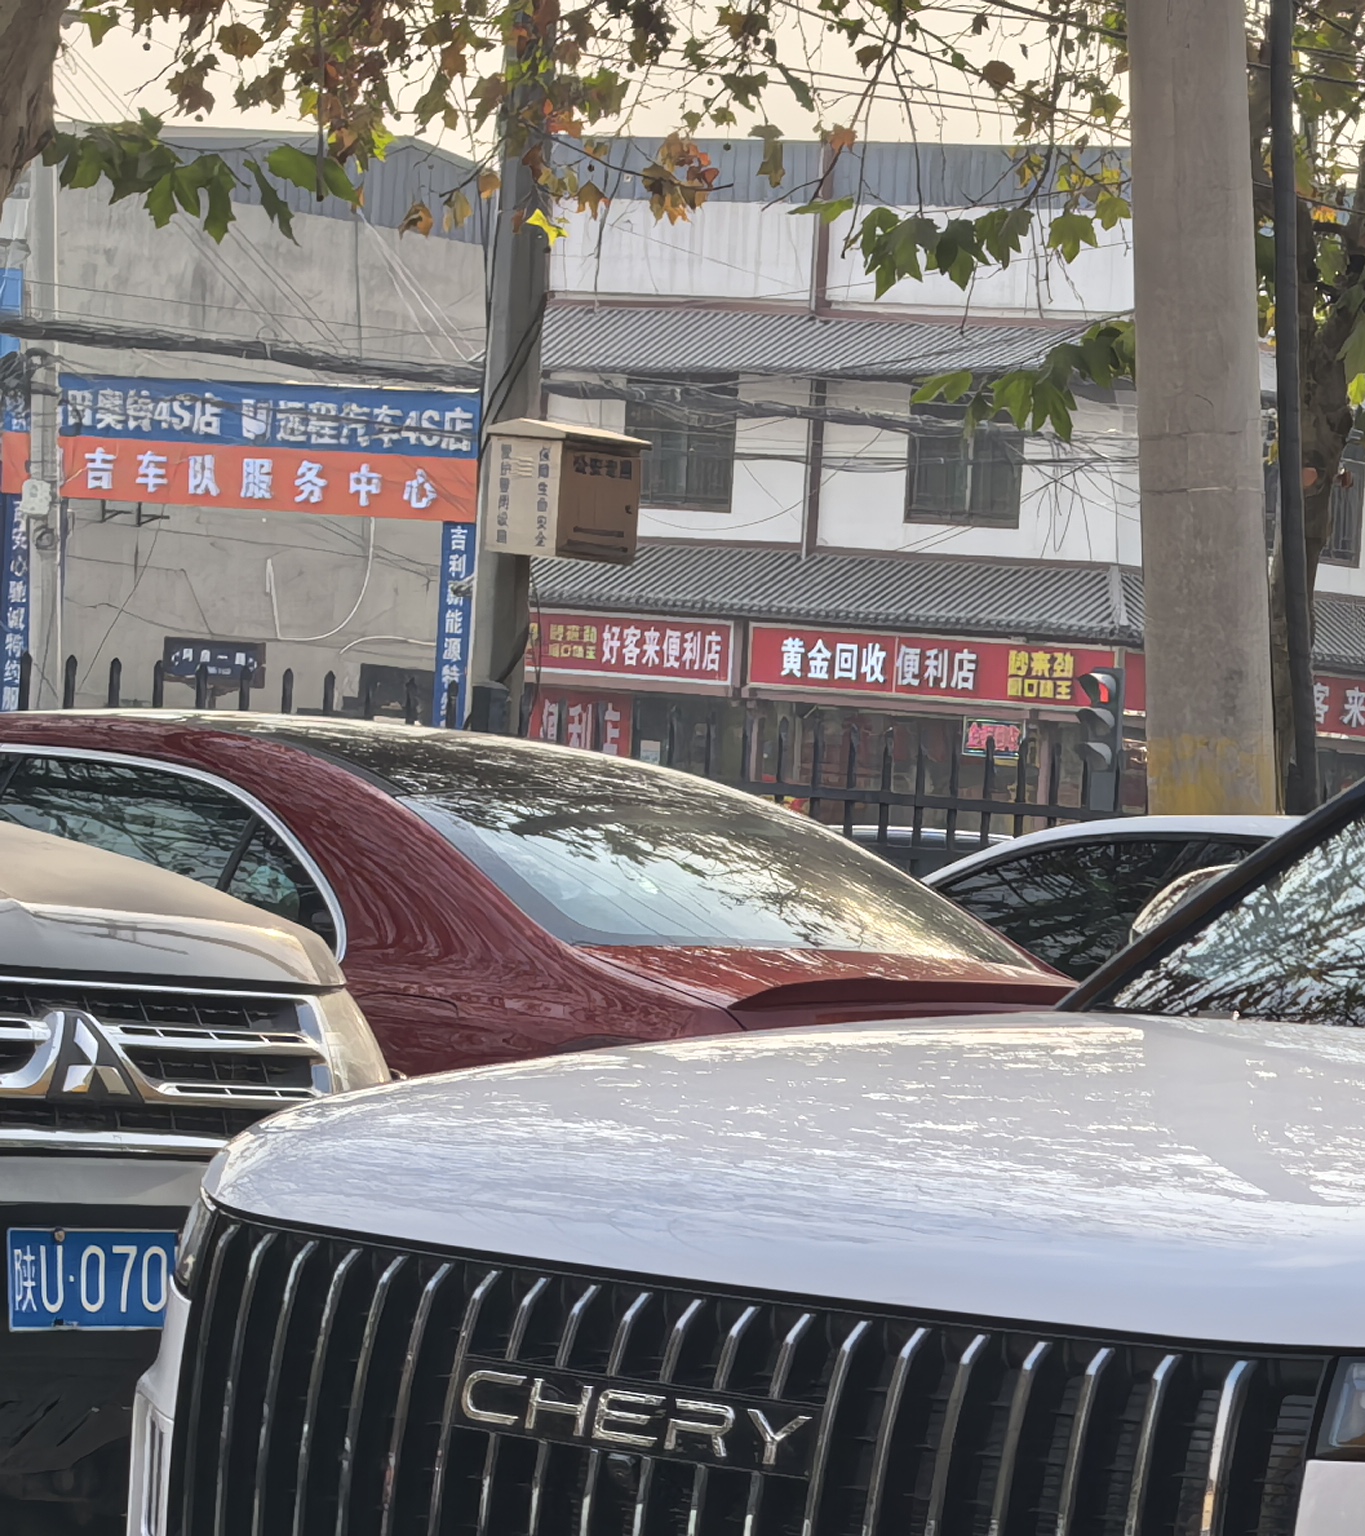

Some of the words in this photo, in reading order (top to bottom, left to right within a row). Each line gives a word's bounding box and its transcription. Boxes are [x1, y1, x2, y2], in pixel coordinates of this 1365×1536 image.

[602, 624, 722, 671] 好客来便利店
[14, 1244, 178, 1313] 陕U·070
[461, 1369, 813, 1465] CHERY
